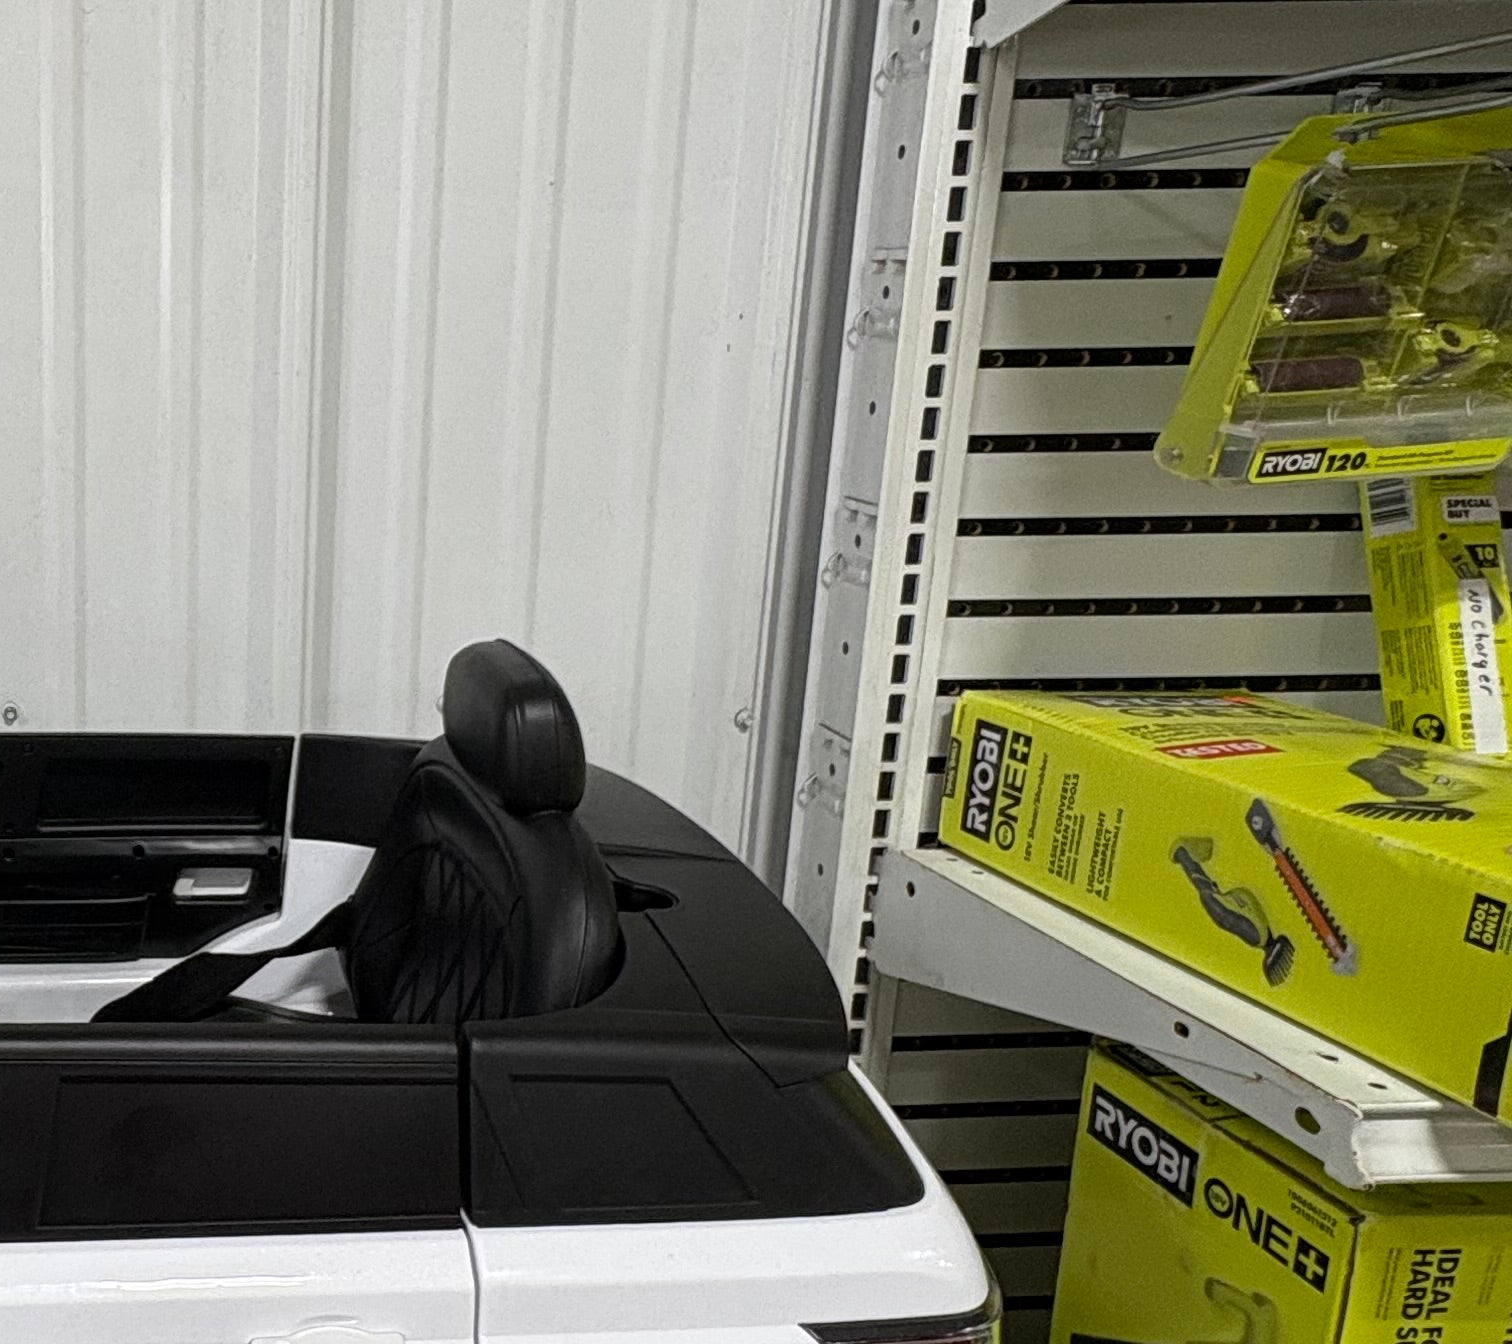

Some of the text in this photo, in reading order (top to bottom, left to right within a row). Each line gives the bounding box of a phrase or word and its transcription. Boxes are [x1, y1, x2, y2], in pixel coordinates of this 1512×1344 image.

[1260, 452, 1322, 474] RYOBI
[1325, 452, 1367, 473] 120
[1446, 498, 1493, 509] SPECIAL
[966, 728, 1003, 833] RYOBI
[1086, 810, 1107, 894] LIGHTWEIGHT
[1096, 829, 1113, 886] COMPACT
[1469, 902, 1489, 940] TOOL
[1482, 903, 1501, 946] ONLY
[1094, 1095, 1190, 1193] RYOBI
[1401, 1249, 1436, 1321] HARD
[1425, 1248, 1462, 1320] IDEAL
